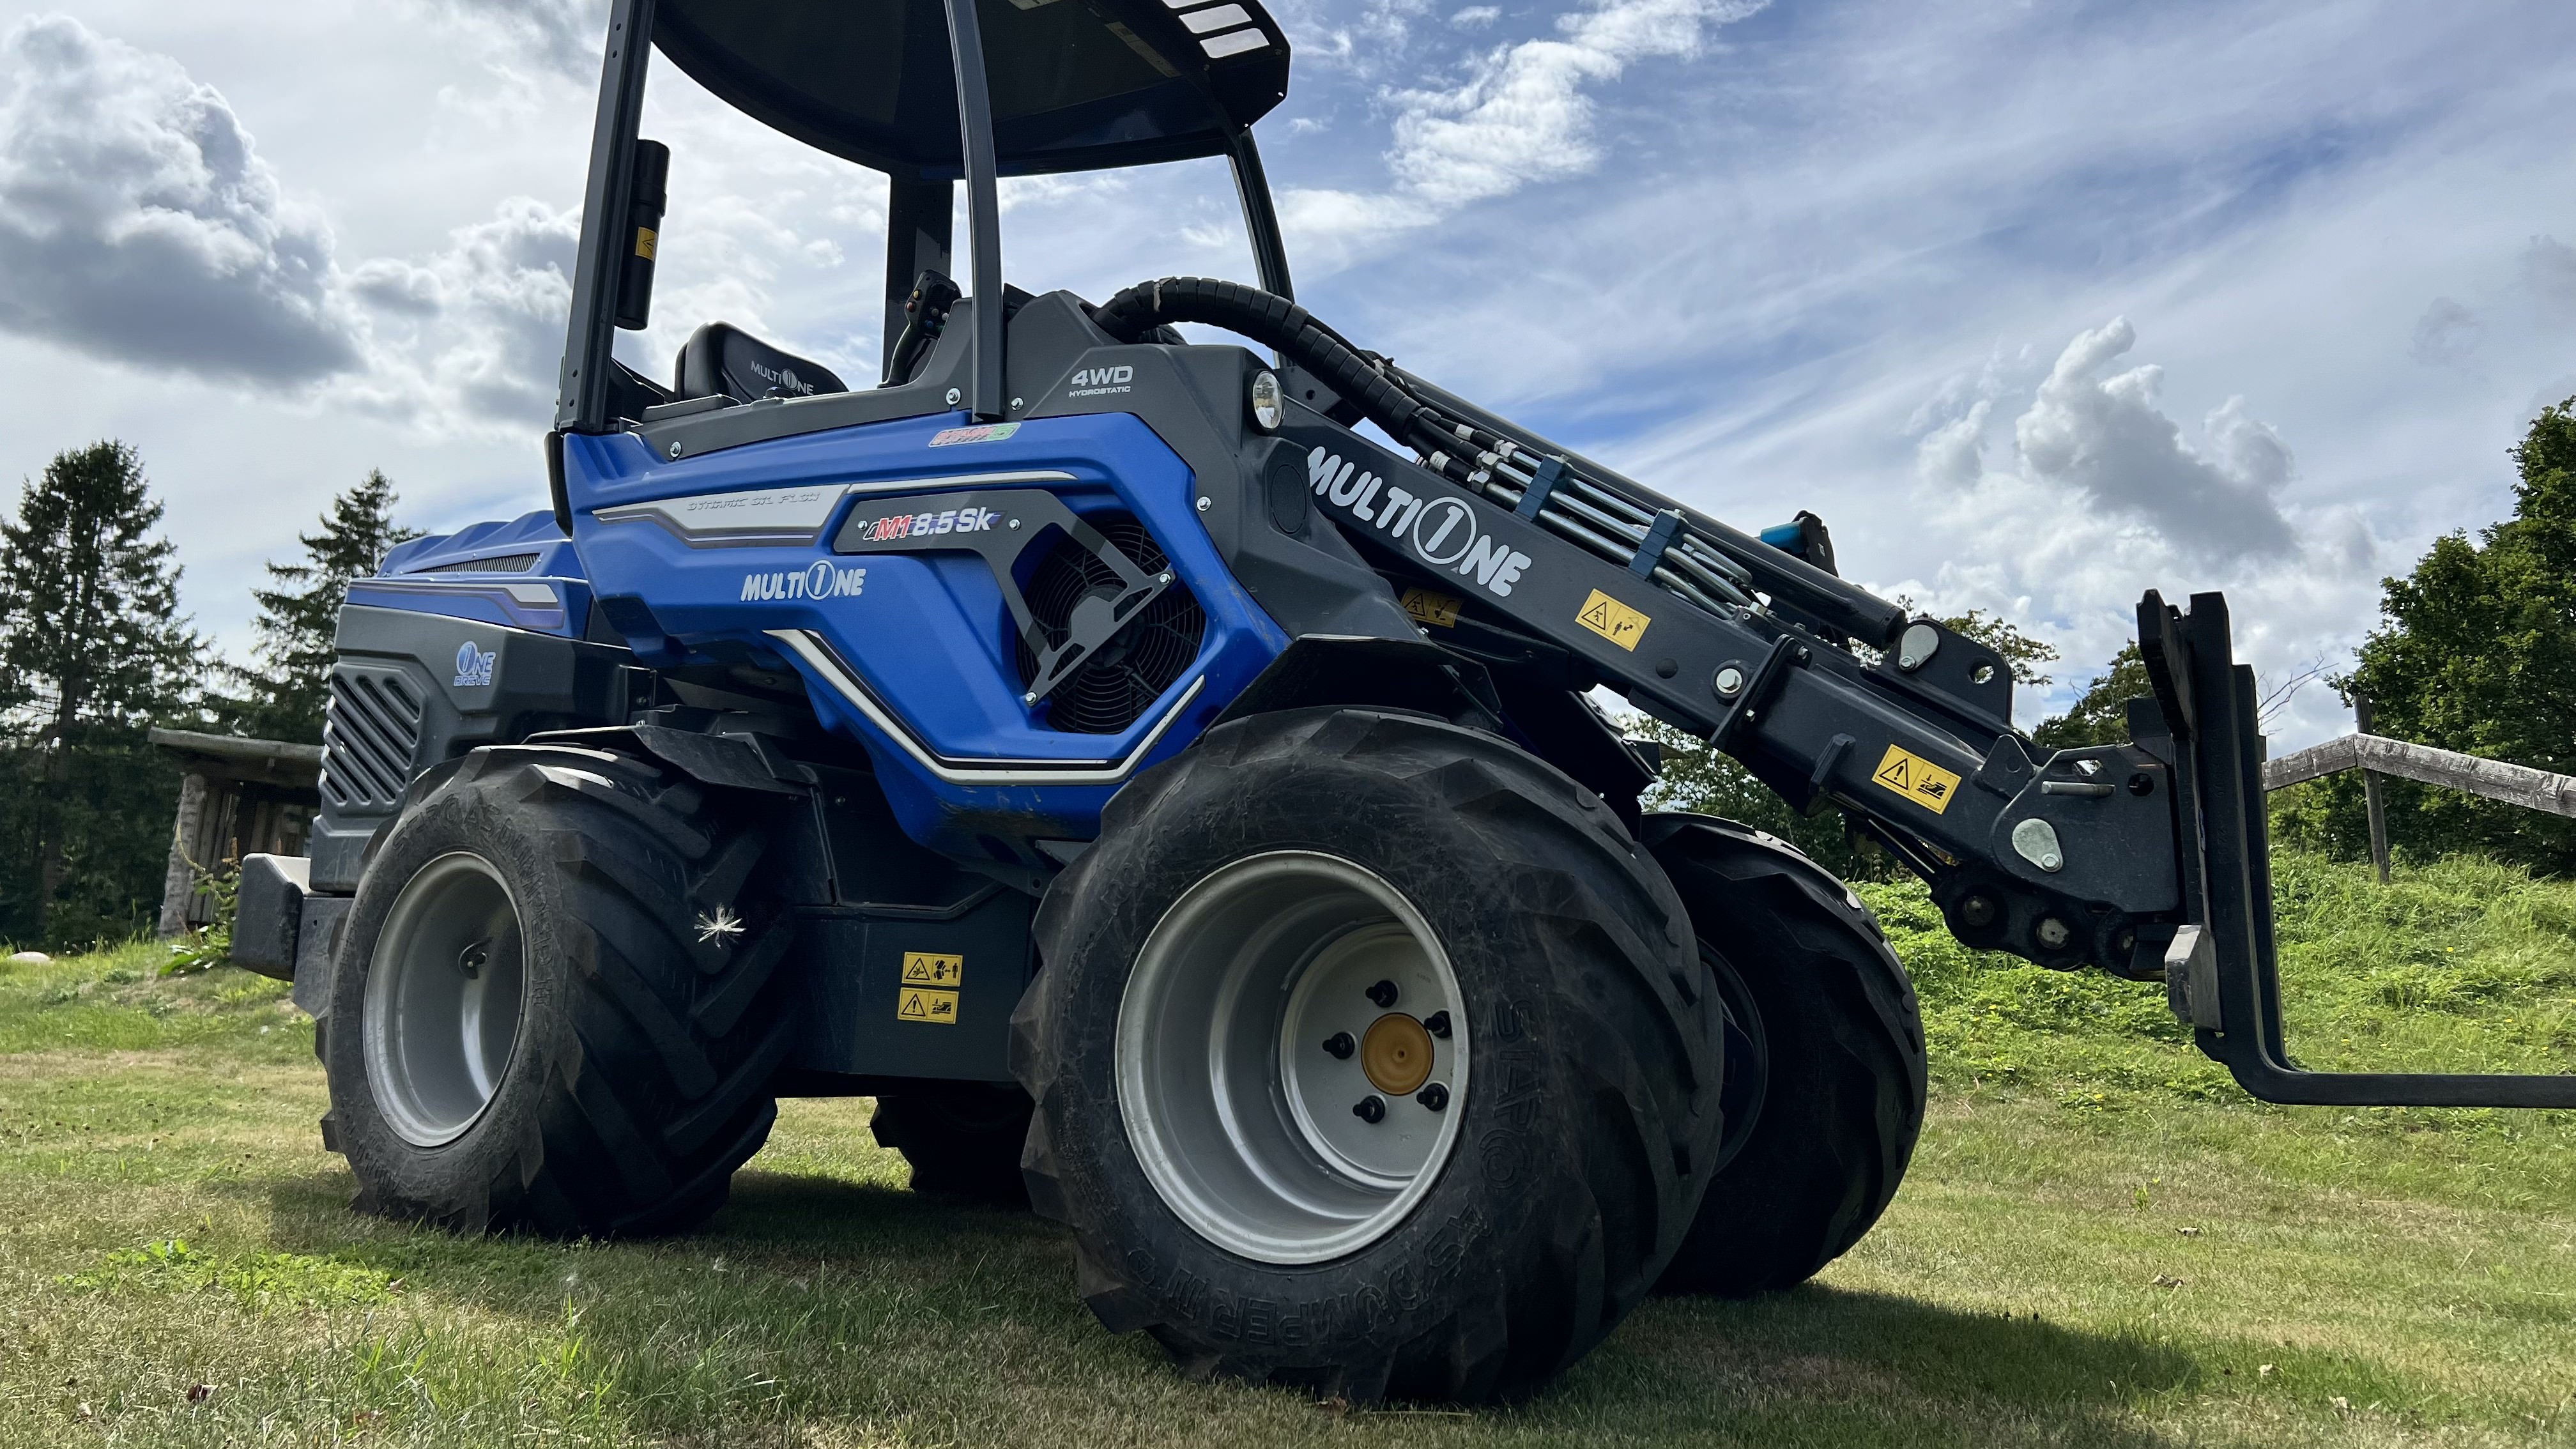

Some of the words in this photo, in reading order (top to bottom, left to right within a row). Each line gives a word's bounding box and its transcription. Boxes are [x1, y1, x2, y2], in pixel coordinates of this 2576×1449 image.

[1071, 365, 1133, 386] 4WD
[1069, 386, 1131, 397] HYDROSTATIC
[687, 498, 748, 511] DYNAMIC
[751, 496, 774, 506] OIL
[778, 493, 820, 504] FLOW
[873, 514, 913, 542] M1
